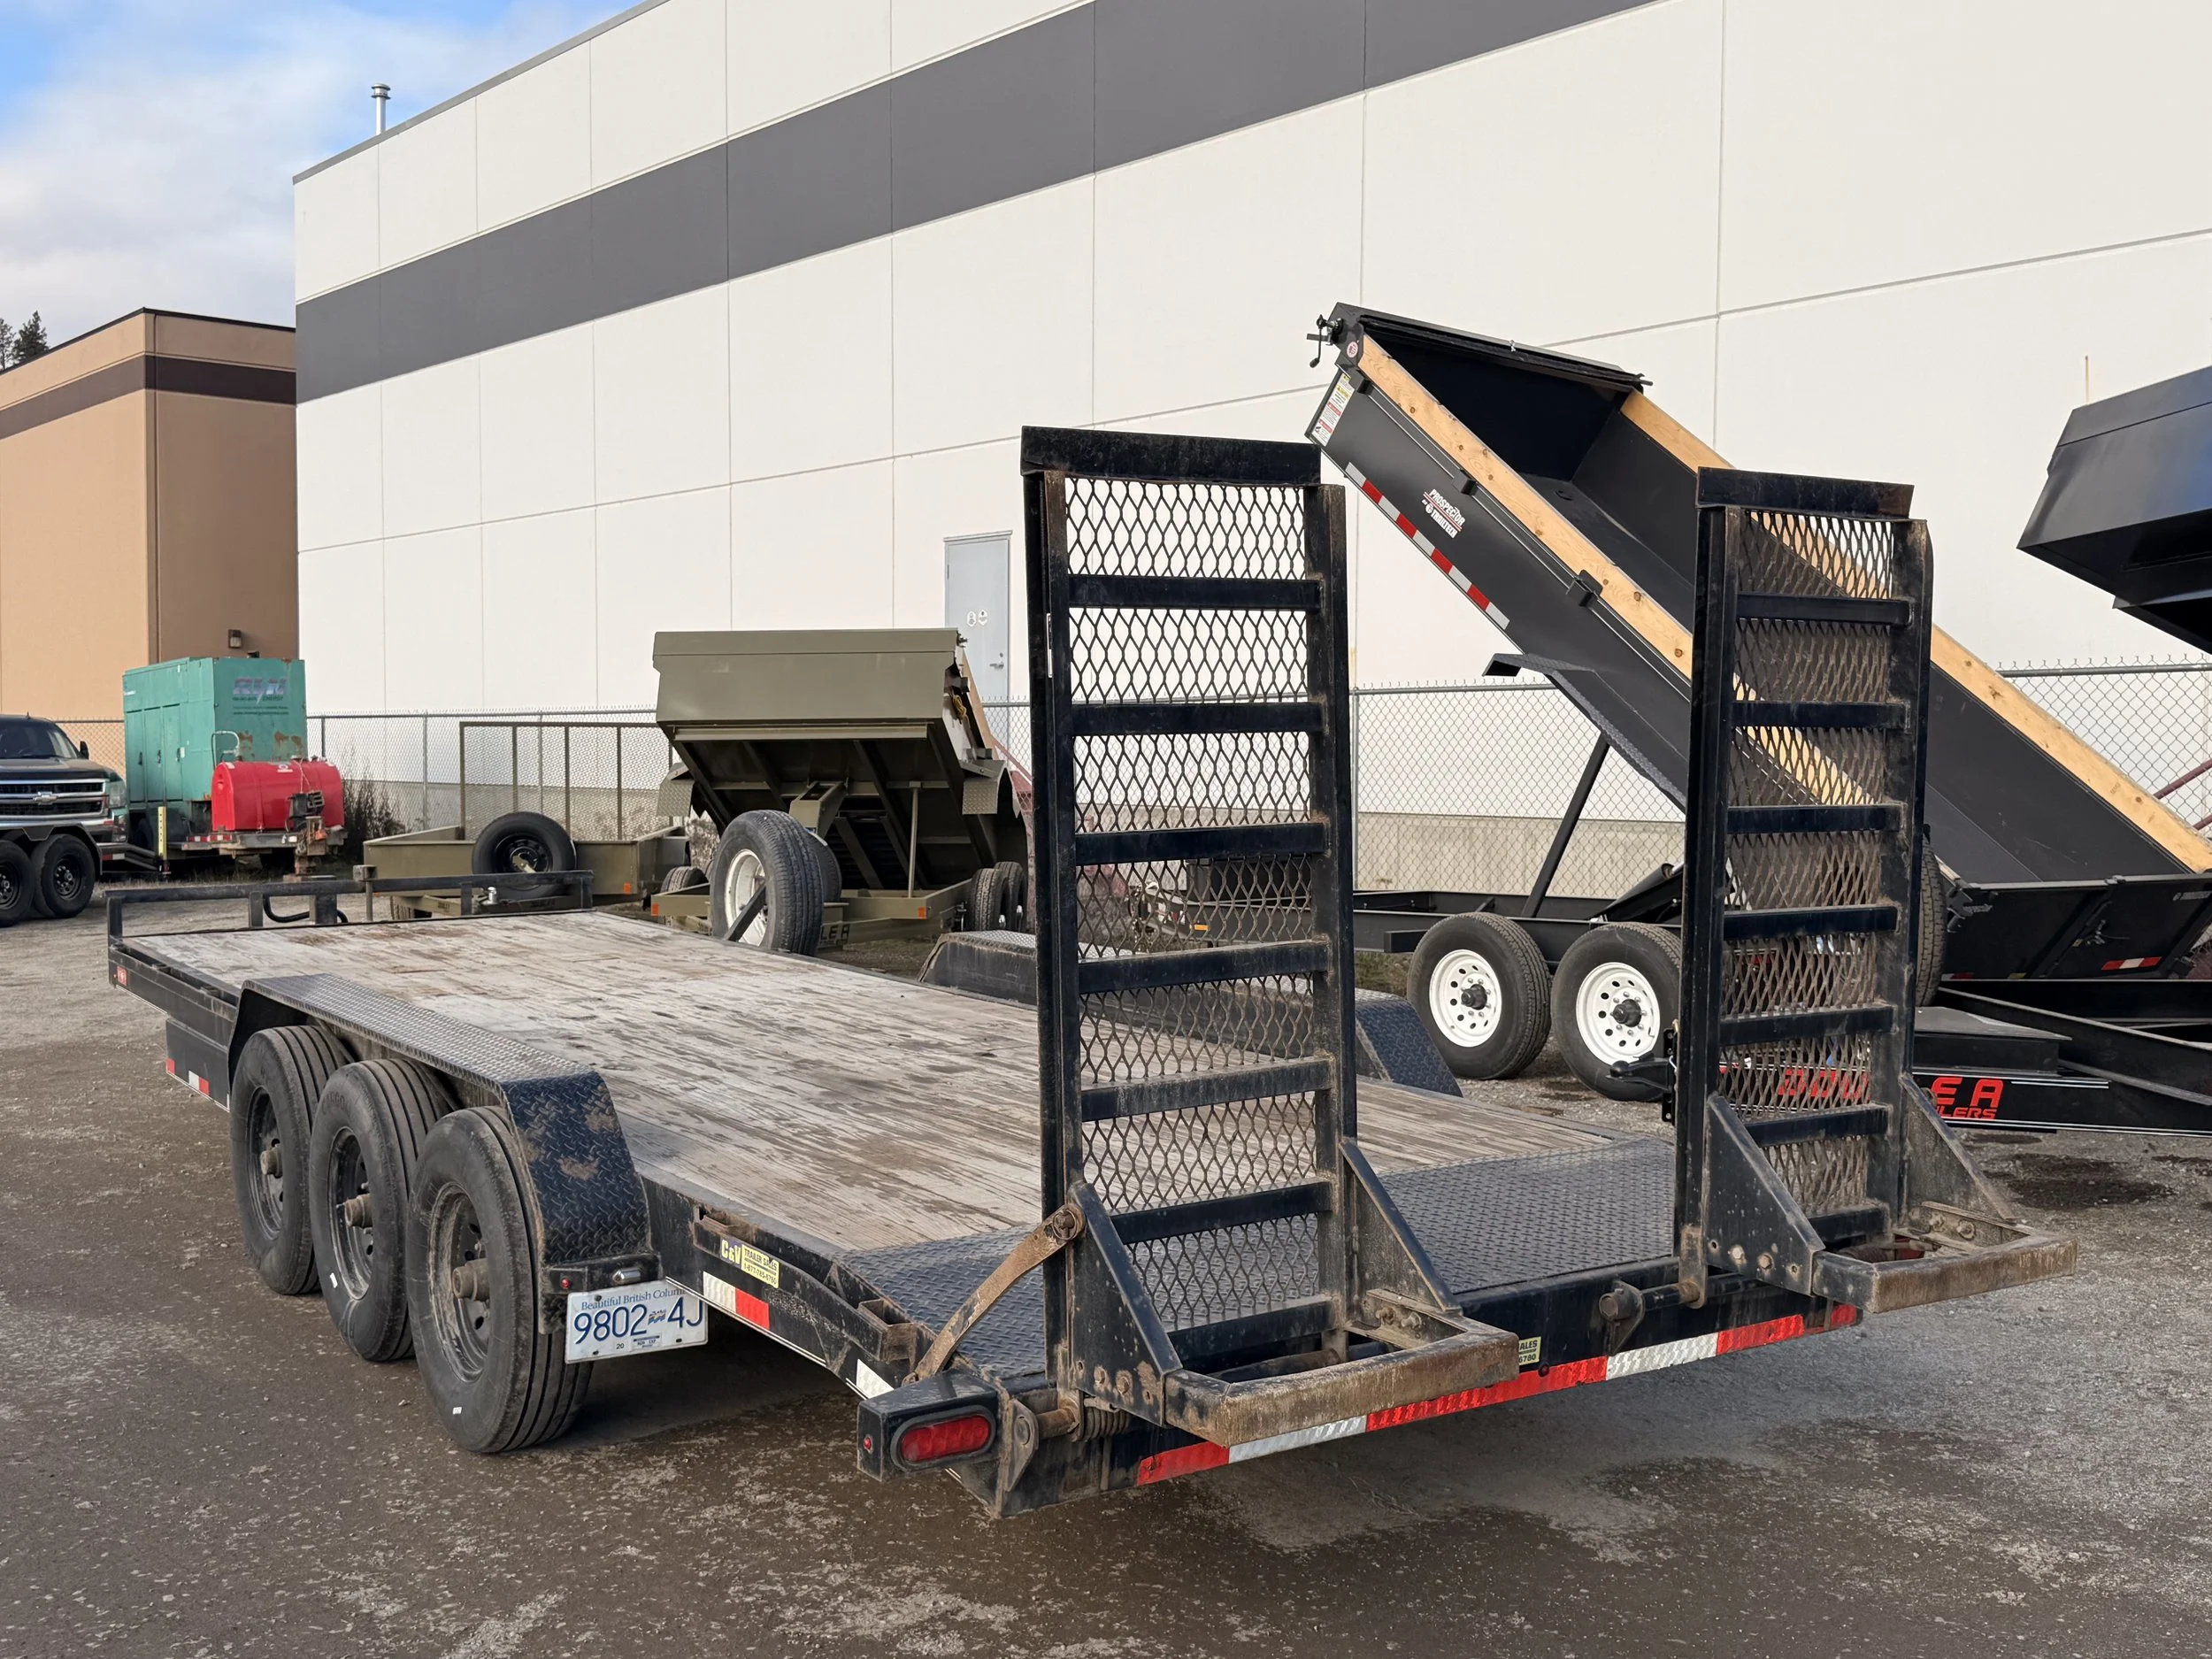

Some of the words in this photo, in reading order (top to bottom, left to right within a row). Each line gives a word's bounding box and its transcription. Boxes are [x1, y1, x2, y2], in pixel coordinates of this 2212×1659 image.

[1429, 488, 1465, 526] PROSPECTOR
[721, 1239, 741, 1264] C&V
[743, 1248, 762, 1263] TRAILER
[580, 1295, 622, 1311] Beautiful
[623, 1291, 652, 1304] British
[652, 1287, 687, 1301] Colum
[573, 1303, 648, 1345] 9802
[1518, 1340, 1538, 1350] ALES
